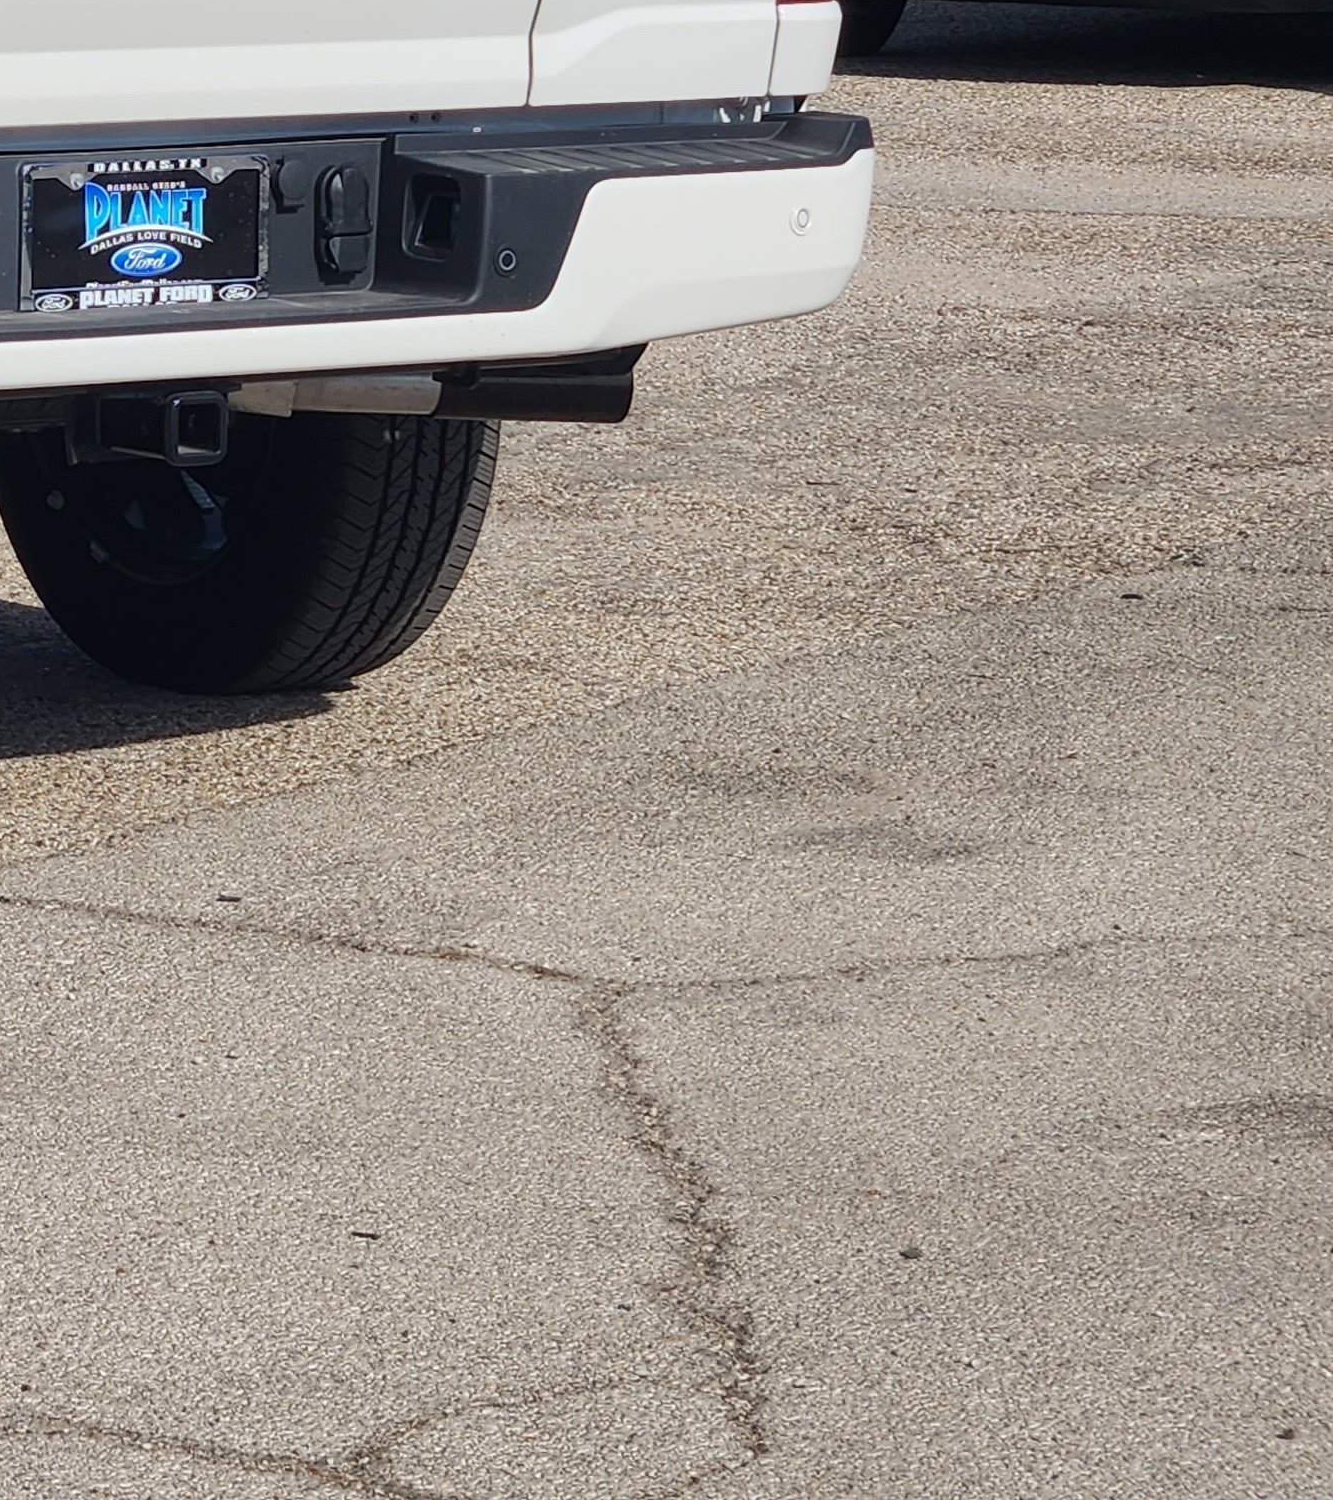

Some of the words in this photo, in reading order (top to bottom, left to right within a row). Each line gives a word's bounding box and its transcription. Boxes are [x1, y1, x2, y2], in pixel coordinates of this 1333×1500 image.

[84, 181, 208, 243] PLANET
[90, 233, 134, 255] DALLAS
[137, 231, 167, 241] LOVE
[170, 233, 203, 248] FIELD
[123, 246, 167, 272] Ford
[78, 288, 155, 310] PLANET
[158, 285, 213, 304] FORD
